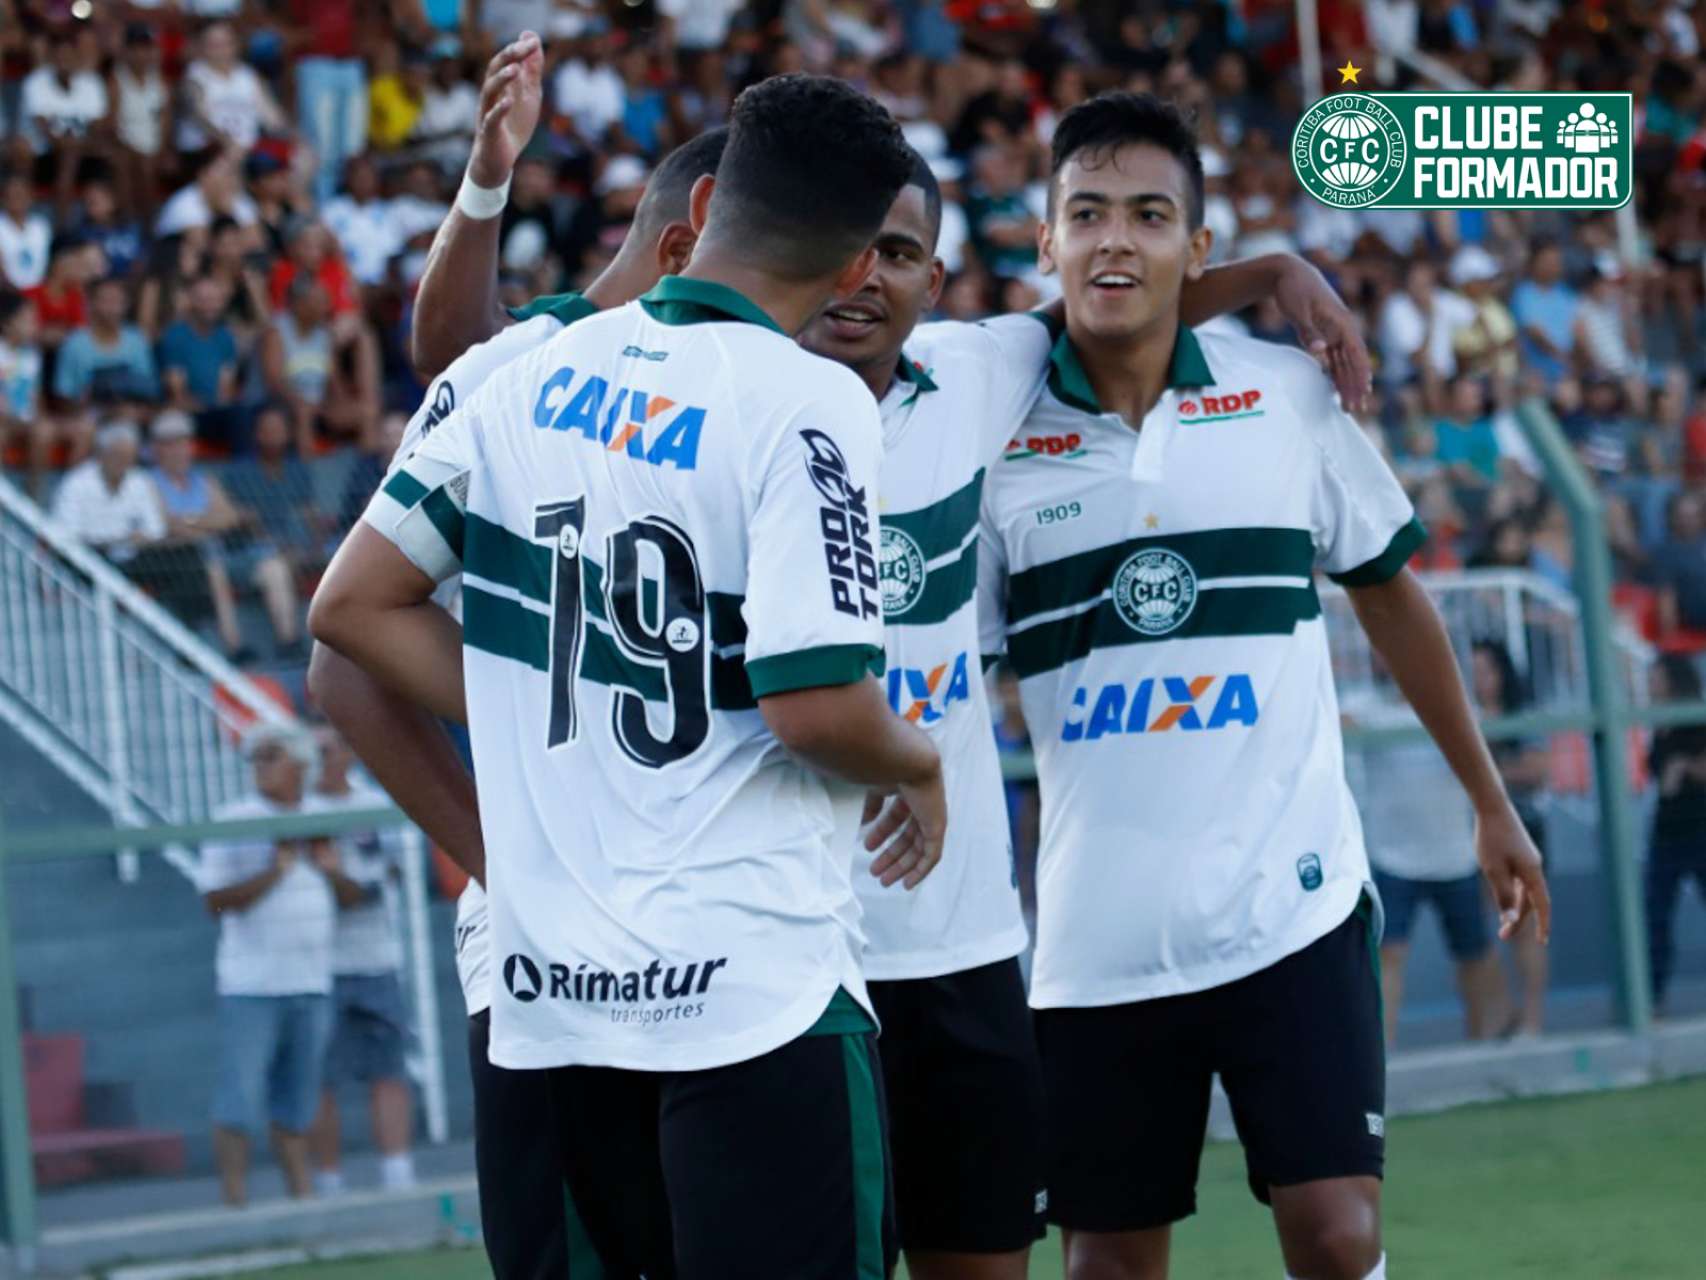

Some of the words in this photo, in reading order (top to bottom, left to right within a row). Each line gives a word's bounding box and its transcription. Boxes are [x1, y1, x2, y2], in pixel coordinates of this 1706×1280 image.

[534, 366, 707, 470] CAIXA
[1200, 390, 1261, 416] RDP
[1026, 433, 1081, 456] RDP
[1036, 501, 1082, 525] 1909
[819, 506, 860, 618] PRO
[844, 479, 878, 622] TORK
[1134, 582, 1178, 603] CFC
[532, 493, 712, 773] 19
[887, 651, 969, 723] IXA
[1061, 673, 1259, 742] CAIXA
[610, 1001, 704, 1026] transportes
